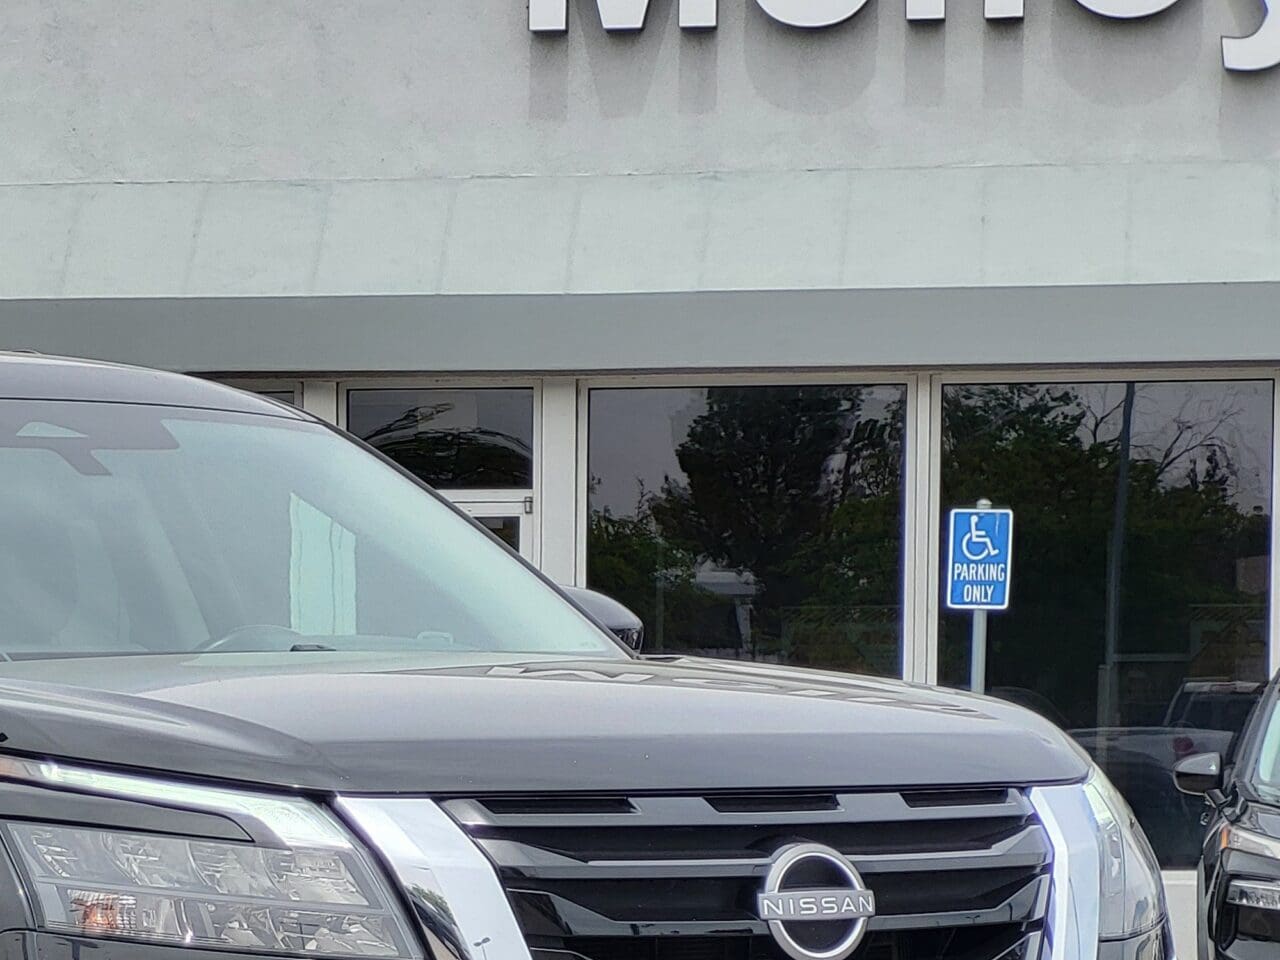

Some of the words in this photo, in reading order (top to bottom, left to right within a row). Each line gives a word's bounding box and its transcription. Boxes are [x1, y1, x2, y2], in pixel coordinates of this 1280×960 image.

[954, 563, 1006, 581] PARKING
[964, 584, 994, 602] ONLY
[763, 896, 873, 915] NISSAN
